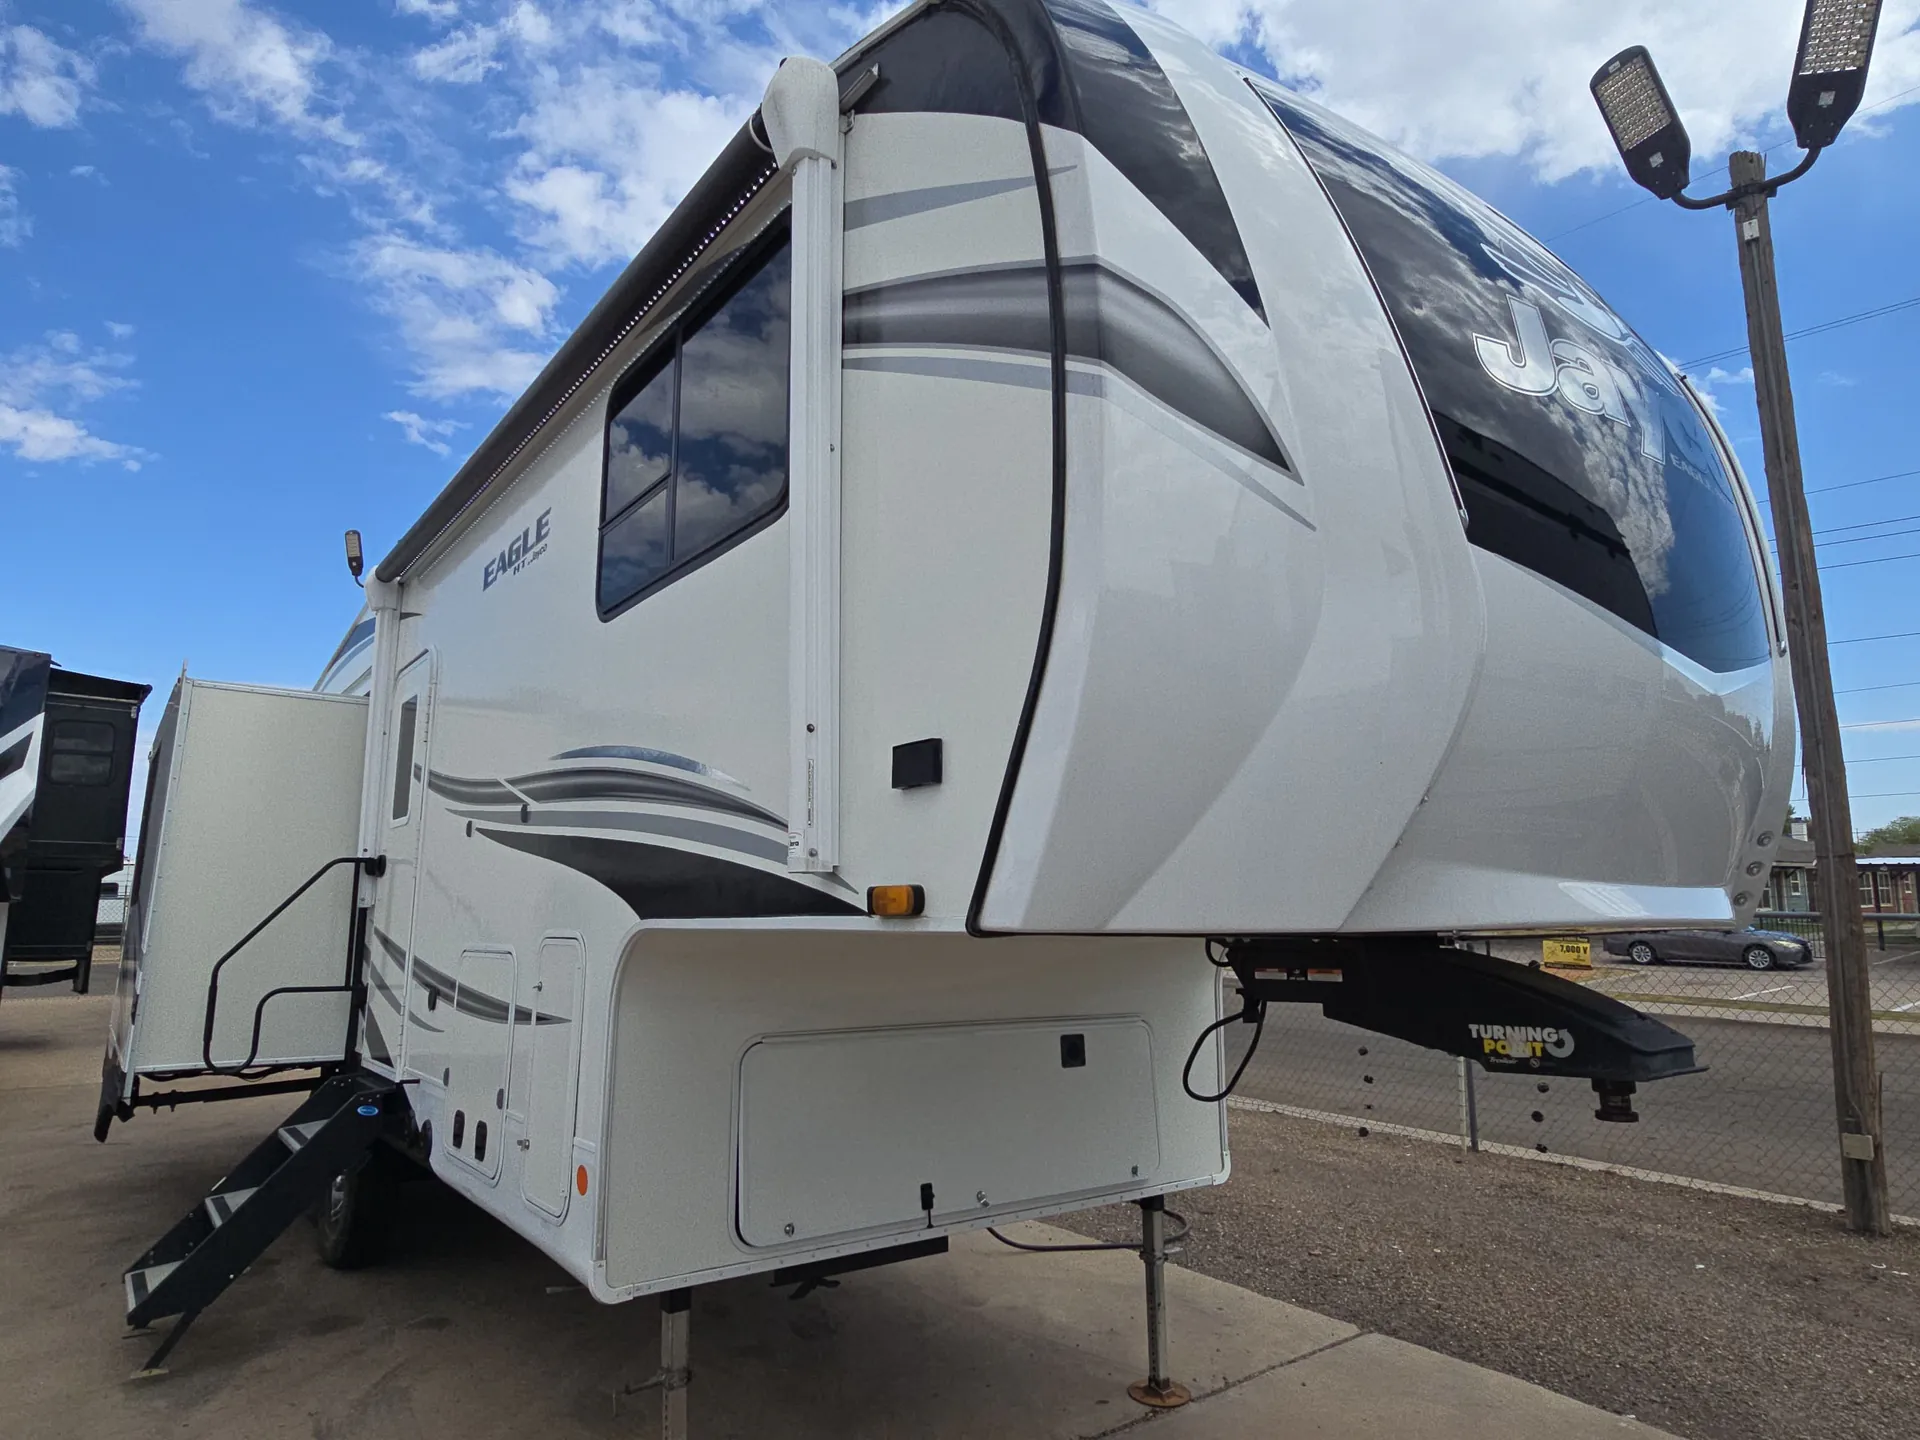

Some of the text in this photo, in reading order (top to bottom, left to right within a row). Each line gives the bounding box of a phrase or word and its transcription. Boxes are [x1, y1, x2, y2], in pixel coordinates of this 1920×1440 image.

[483, 506, 552, 593] EAGLE
[1559, 944, 1581, 954] 7,000
[1467, 1023, 1559, 1043] TURNING
